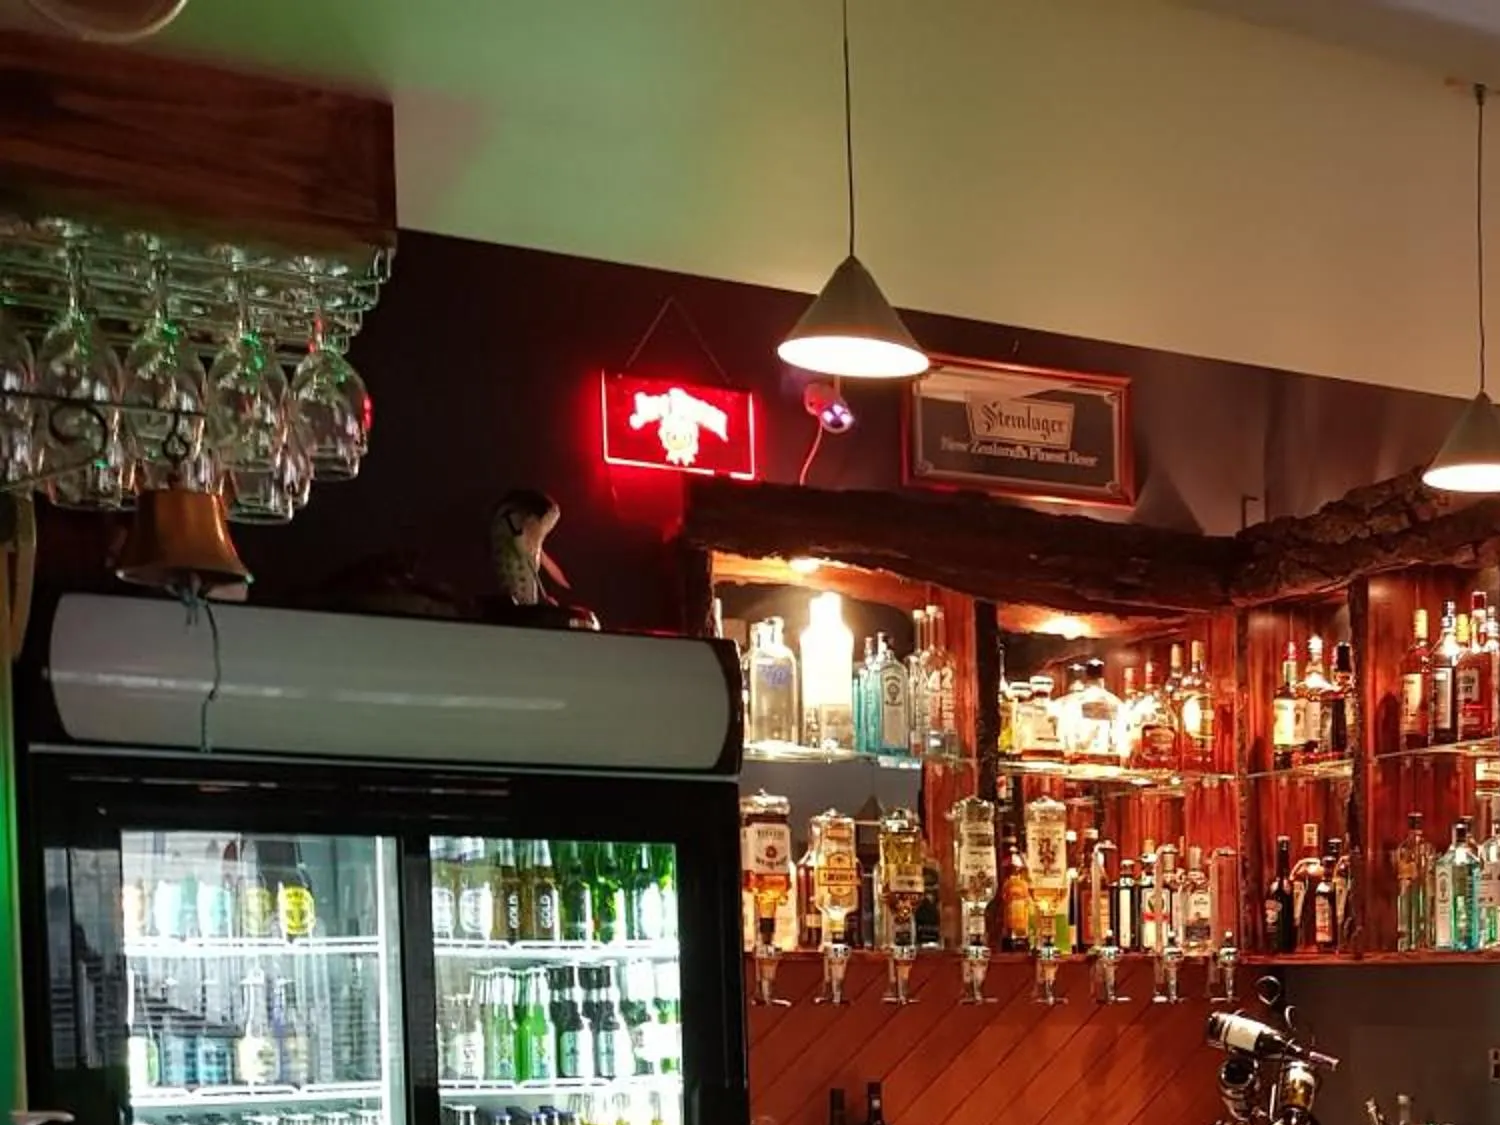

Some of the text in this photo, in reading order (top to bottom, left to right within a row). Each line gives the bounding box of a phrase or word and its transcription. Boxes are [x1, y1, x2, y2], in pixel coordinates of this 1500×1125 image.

[982, 401, 1068, 441] Steinlager
[508, 891, 519, 929] GOLD
[540, 893, 553, 929] GOLD
